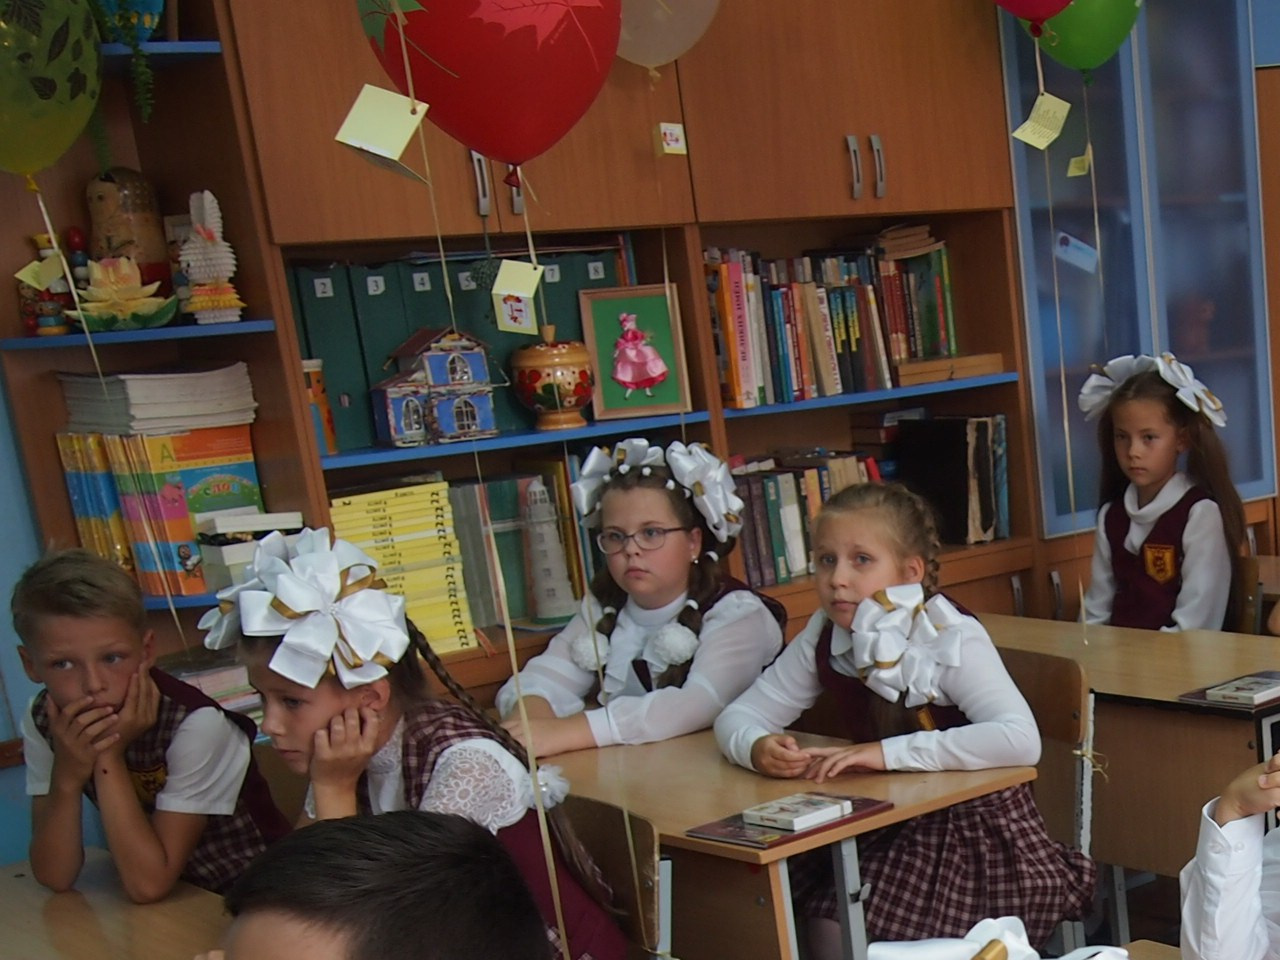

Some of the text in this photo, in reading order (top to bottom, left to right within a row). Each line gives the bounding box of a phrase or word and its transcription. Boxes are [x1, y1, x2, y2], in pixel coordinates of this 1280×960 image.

[372, 279, 380, 292] 3
[418, 277, 426, 289] 4
[464, 275, 472, 286] 5
[320, 282, 328, 294] 2
